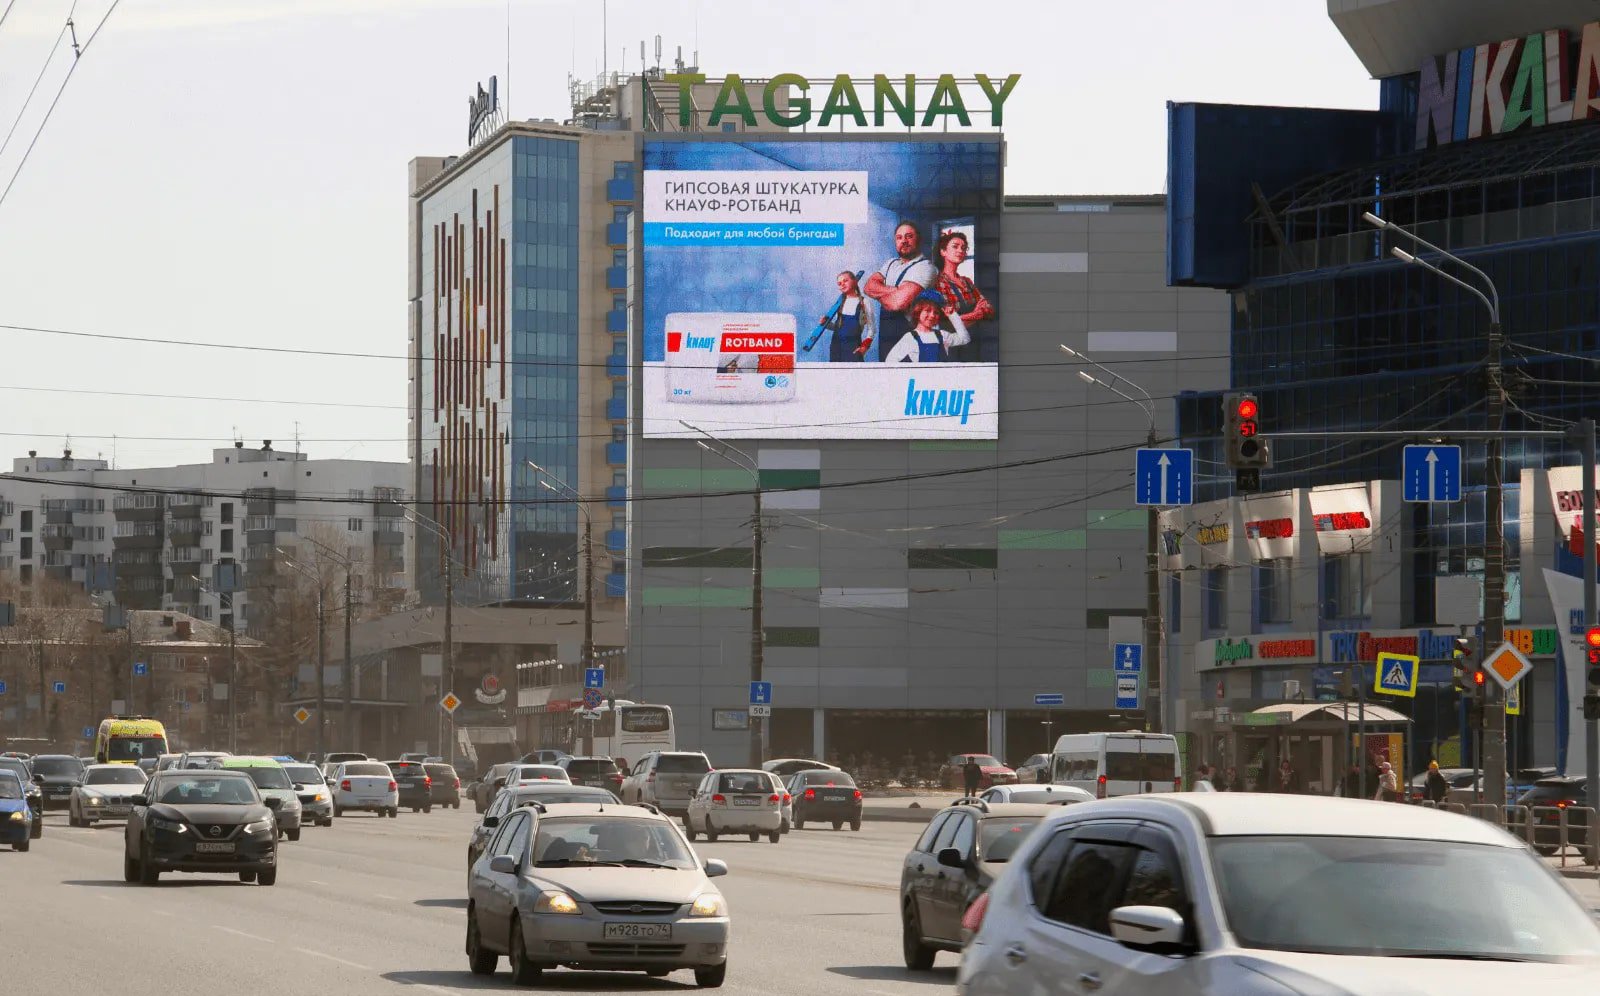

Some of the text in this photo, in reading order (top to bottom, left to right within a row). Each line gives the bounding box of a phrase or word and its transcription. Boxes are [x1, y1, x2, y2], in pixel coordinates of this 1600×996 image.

[664, 73, 1022, 127] TAGANAY
[665, 181, 859, 195] ГИПСОВАЯ ШТУКАТУРКА
[665, 198, 801, 214] КНАУФ-РОТБАНД
[664, 227, 837, 241] Подходит для любой бригады
[725, 337, 783, 348] ROTBAND
[753, 707, 764, 715] 50
